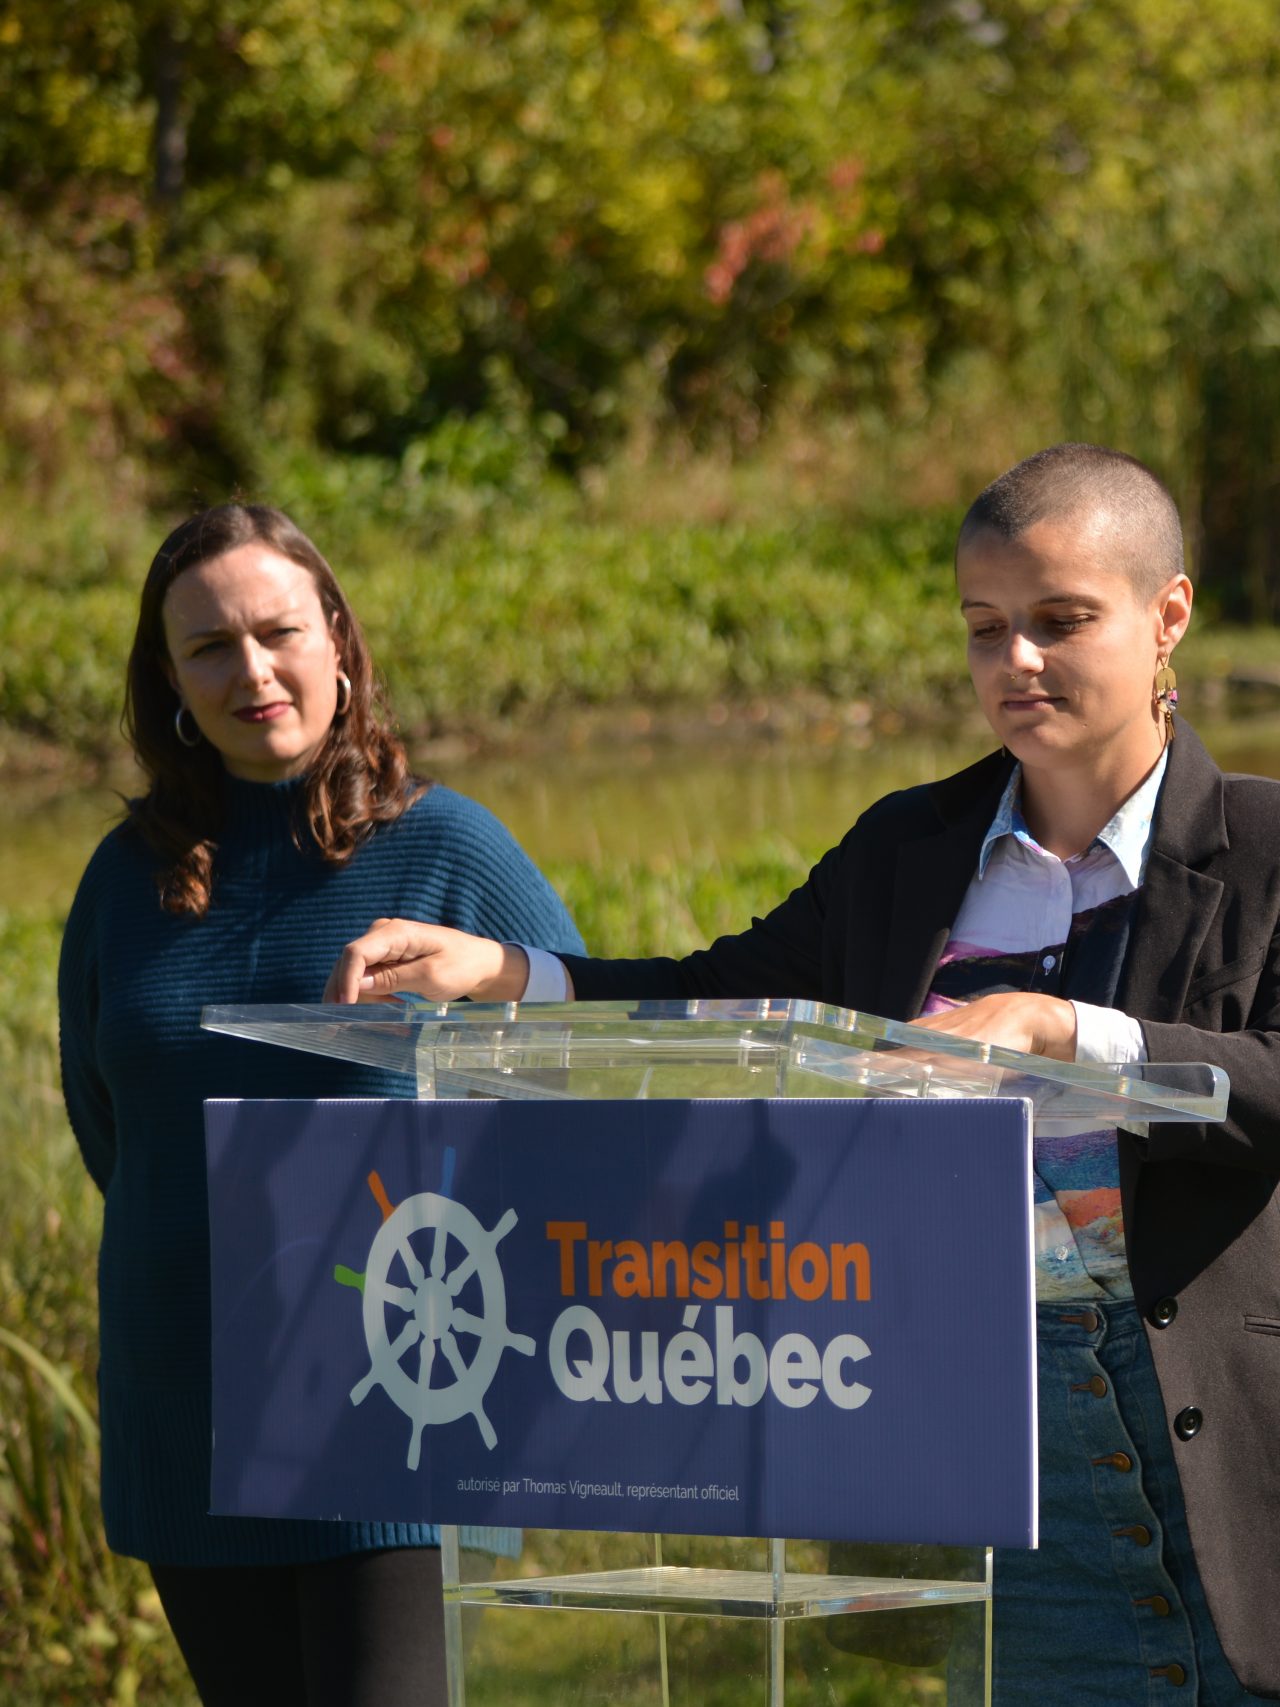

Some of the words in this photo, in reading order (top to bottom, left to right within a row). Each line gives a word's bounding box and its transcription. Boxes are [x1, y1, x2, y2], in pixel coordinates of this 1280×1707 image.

[547, 1221, 870, 1302] Transition
[548, 1306, 872, 1410] Québec
[457, 1477, 501, 1492] autorisé
[503, 1480, 520, 1495] par
[523, 1478, 567, 1494] Thomas
[569, 1480, 624, 1499] Vigneault,
[627, 1483, 698, 1501] représentant
[701, 1484, 739, 1501] officiel
